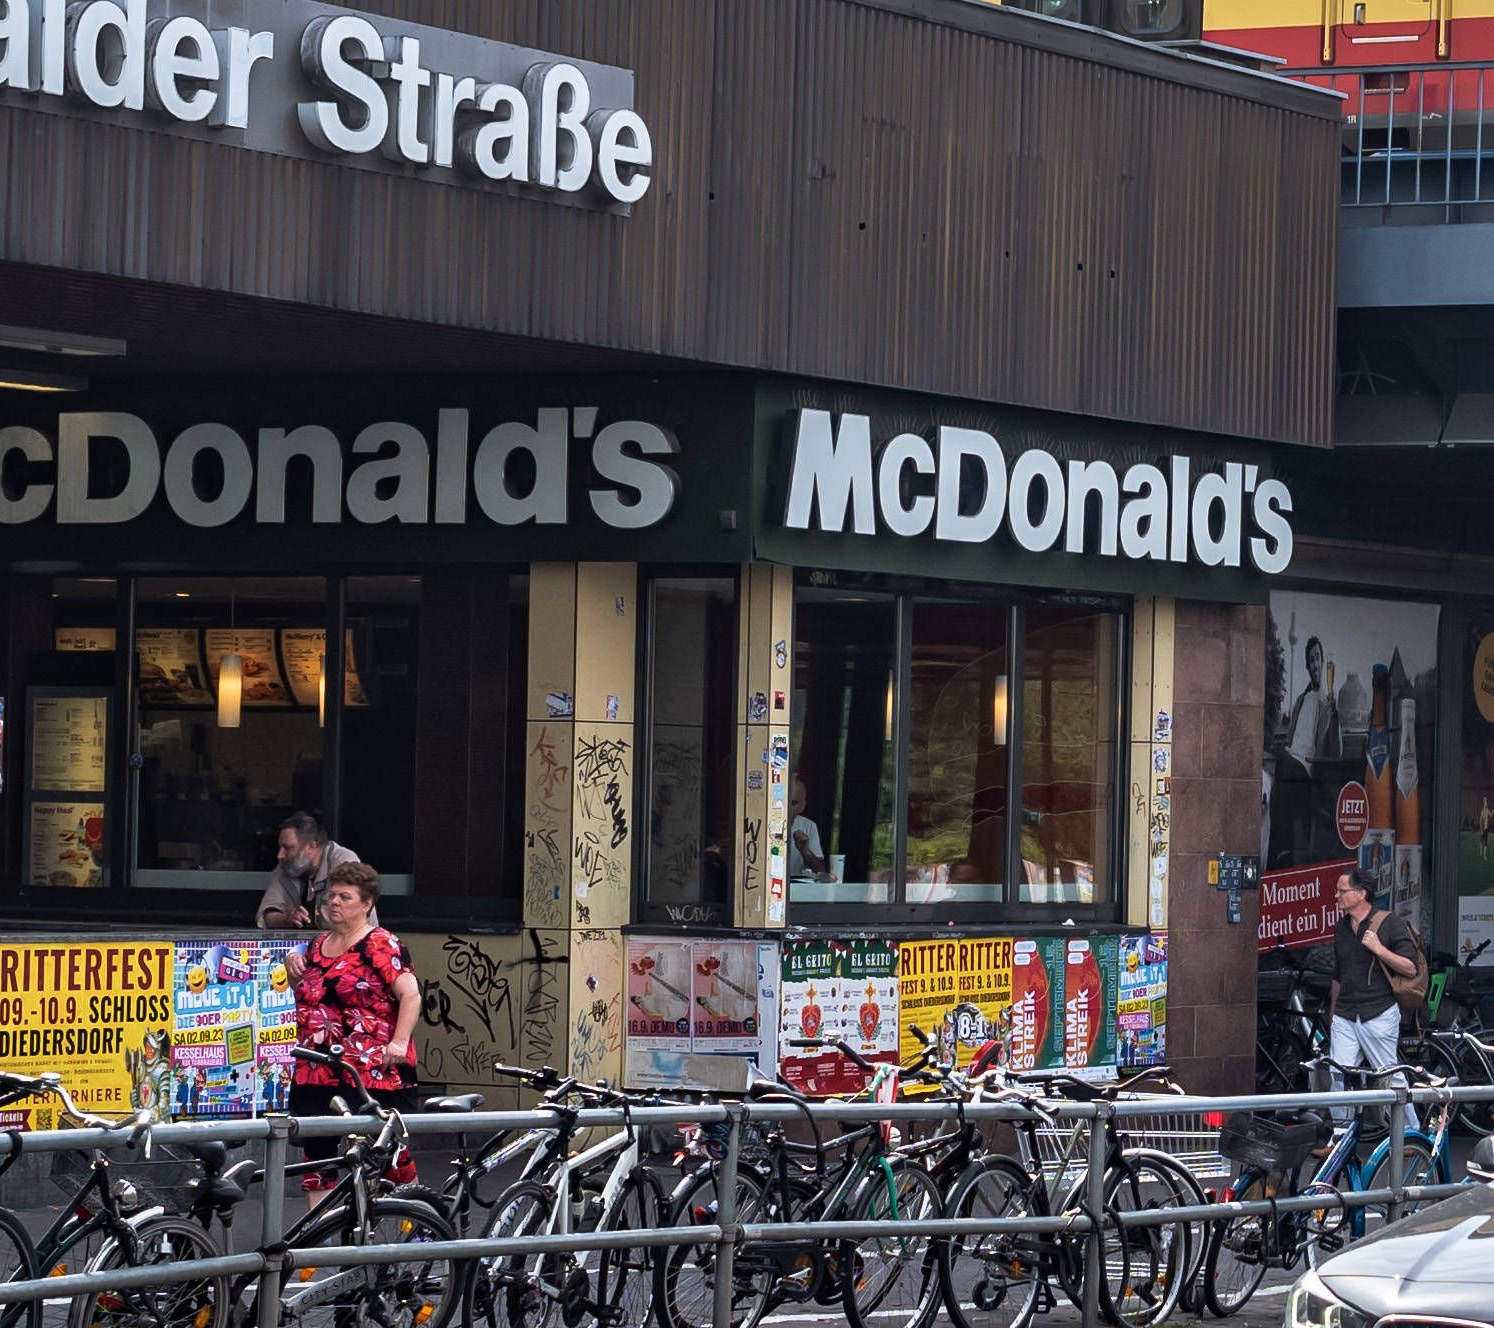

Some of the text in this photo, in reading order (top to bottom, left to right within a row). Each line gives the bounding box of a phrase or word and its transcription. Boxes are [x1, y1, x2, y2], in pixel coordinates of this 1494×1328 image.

[299, 14, 653, 203] Straße
[783, 407, 1296, 575] McDonald's
[1341, 799, 1364, 814] JETZT
[1262, 876, 1321, 906] Moment
[1258, 912, 1293, 939] dient
[1296, 908, 1318, 932] ein
[1, 948, 170, 992] RITTERFEST
[791, 954, 832, 969] EL GRITO
[851, 953, 891, 966] EL GRITO
[901, 944, 956, 976] RITTER
[959, 941, 1011, 974] RITTER
[901, 976, 956, 994] FEST 9. & 10.9.
[959, 974, 1011, 991] FEST 9. & 10.9.
[1055, 939, 1065, 1052] SEPTEMBER
[89, 995, 170, 1023] SCHLOSS
[177, 1016, 195, 1028] DIE
[196, 1013, 221, 1025] 90ER
[262, 1017, 279, 1028] DIE
[174, 1029, 224, 1045] SA 02.09.23
[259, 1032, 270, 1044] SA
[650, 1020, 675, 1033] DEMO
[717, 1020, 742, 1033] DEMO
[1012, 1000, 1024, 1070] KLIMA
[1023, 990, 1035, 1068] STREIK
[1066, 997, 1078, 1068] KLIMA
[1077, 988, 1089, 1065] STREIK
[174, 1046, 225, 1059] KESSELHAUS
